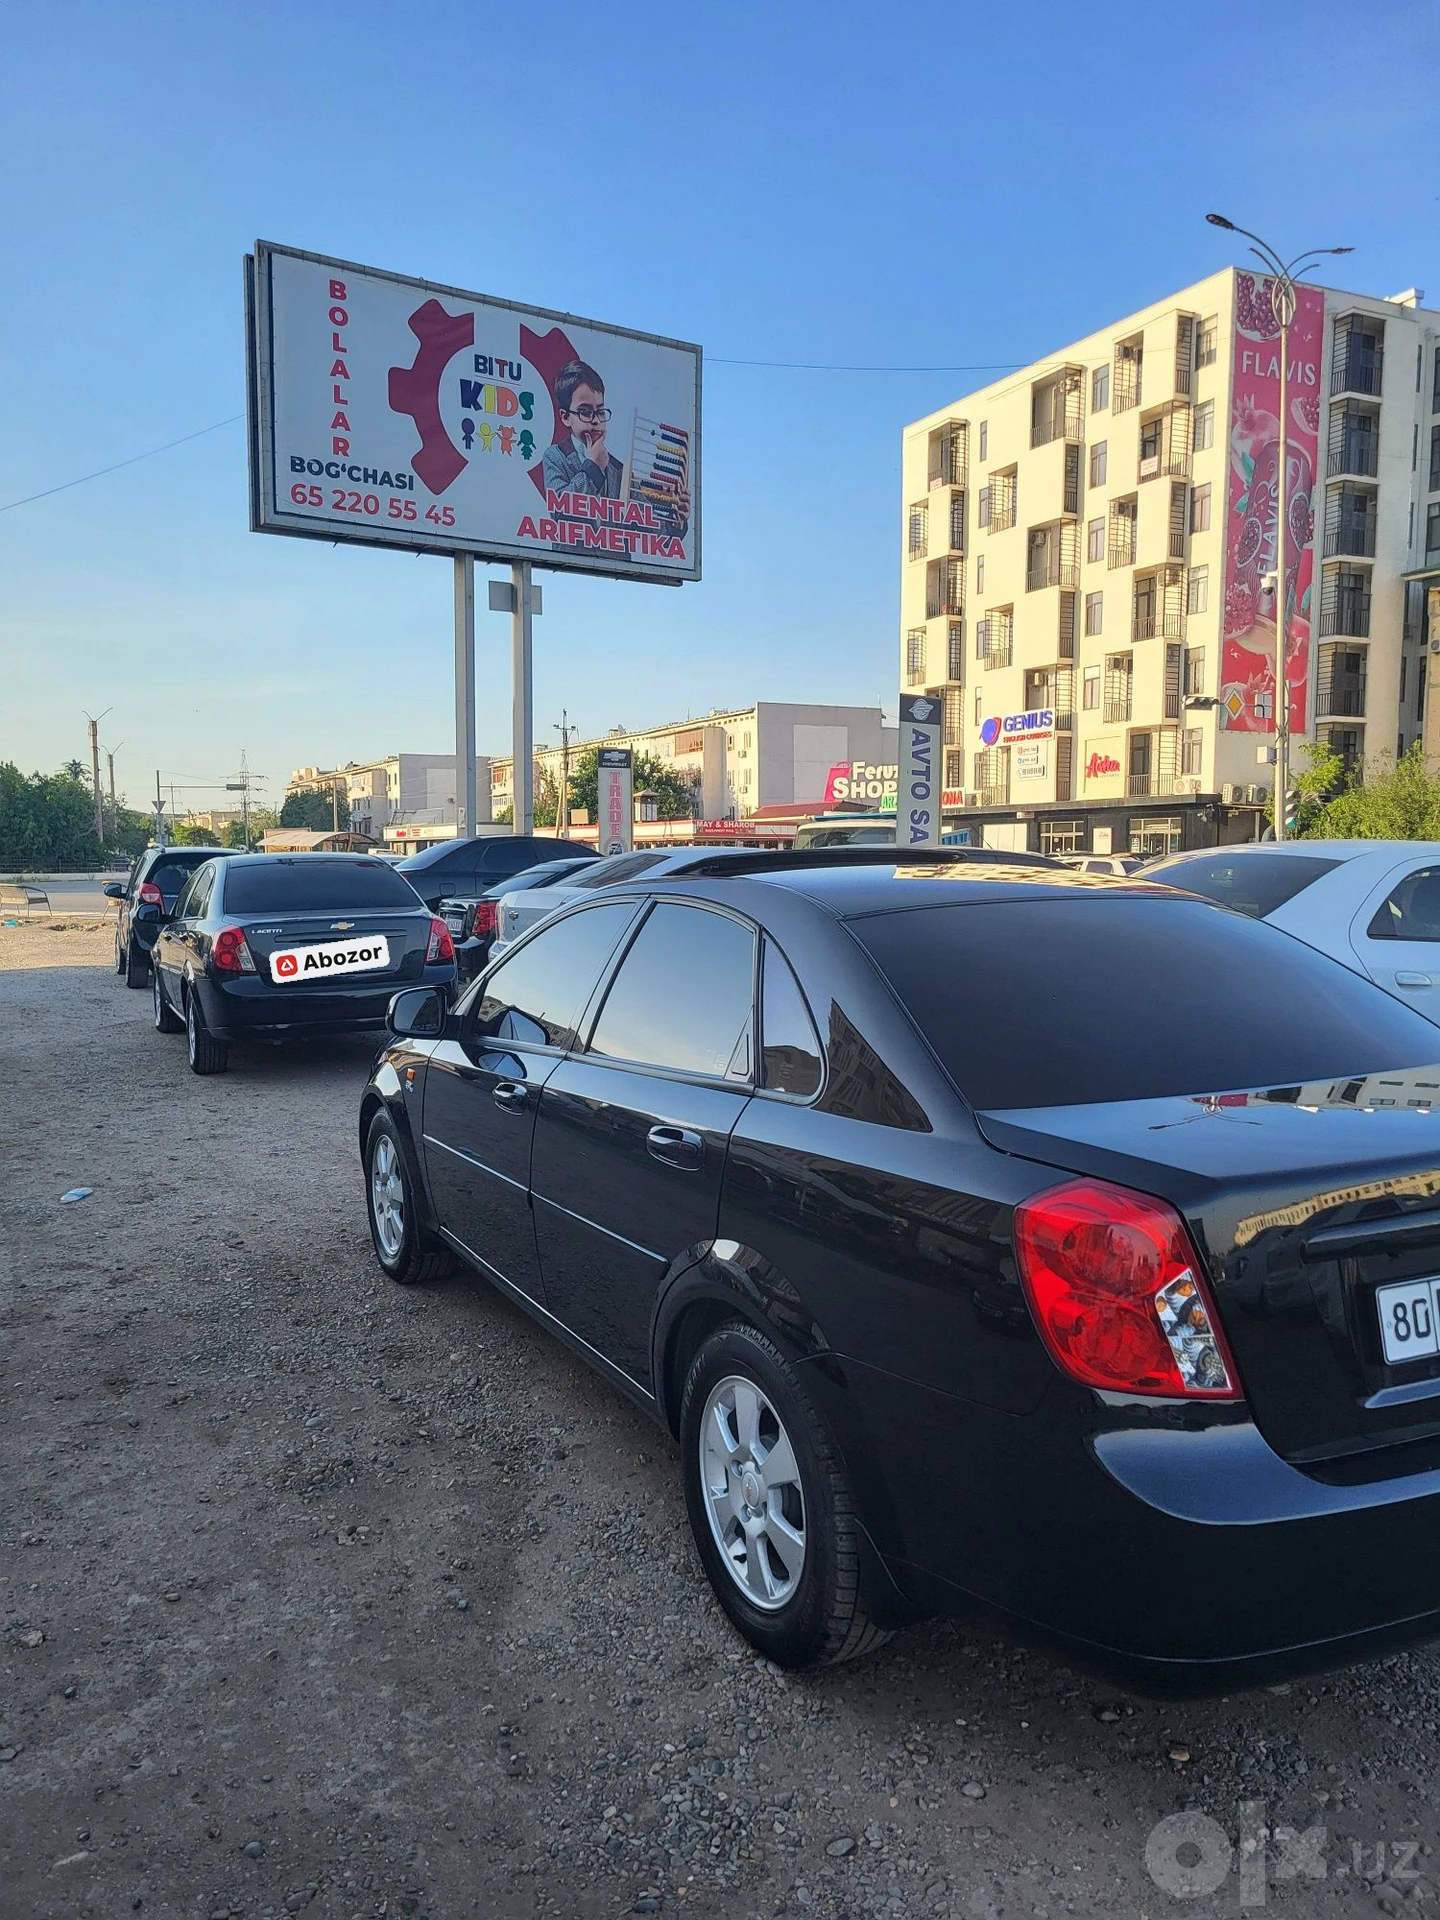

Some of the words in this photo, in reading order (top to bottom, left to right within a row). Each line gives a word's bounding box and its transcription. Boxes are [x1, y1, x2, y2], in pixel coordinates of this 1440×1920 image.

[328, 279, 351, 457] BOLALAR
[474, 353, 522, 381] BITU
[459, 378, 535, 421] KIDS
[290, 483, 324, 507] 65
[331, 489, 380, 515] 220
[387, 497, 417, 521] 55
[424, 504, 456, 527] 45
[547, 489, 660, 528] MENTAL
[516, 515, 687, 560] ARIFMETIKA
[1003, 710, 1053, 733] GENIUS
[911, 728, 931, 800] AVTO
[609, 771, 622, 837] TRADE
[832, 777, 898, 799] SHOP
[1393, 1298, 1431, 1342] 80
